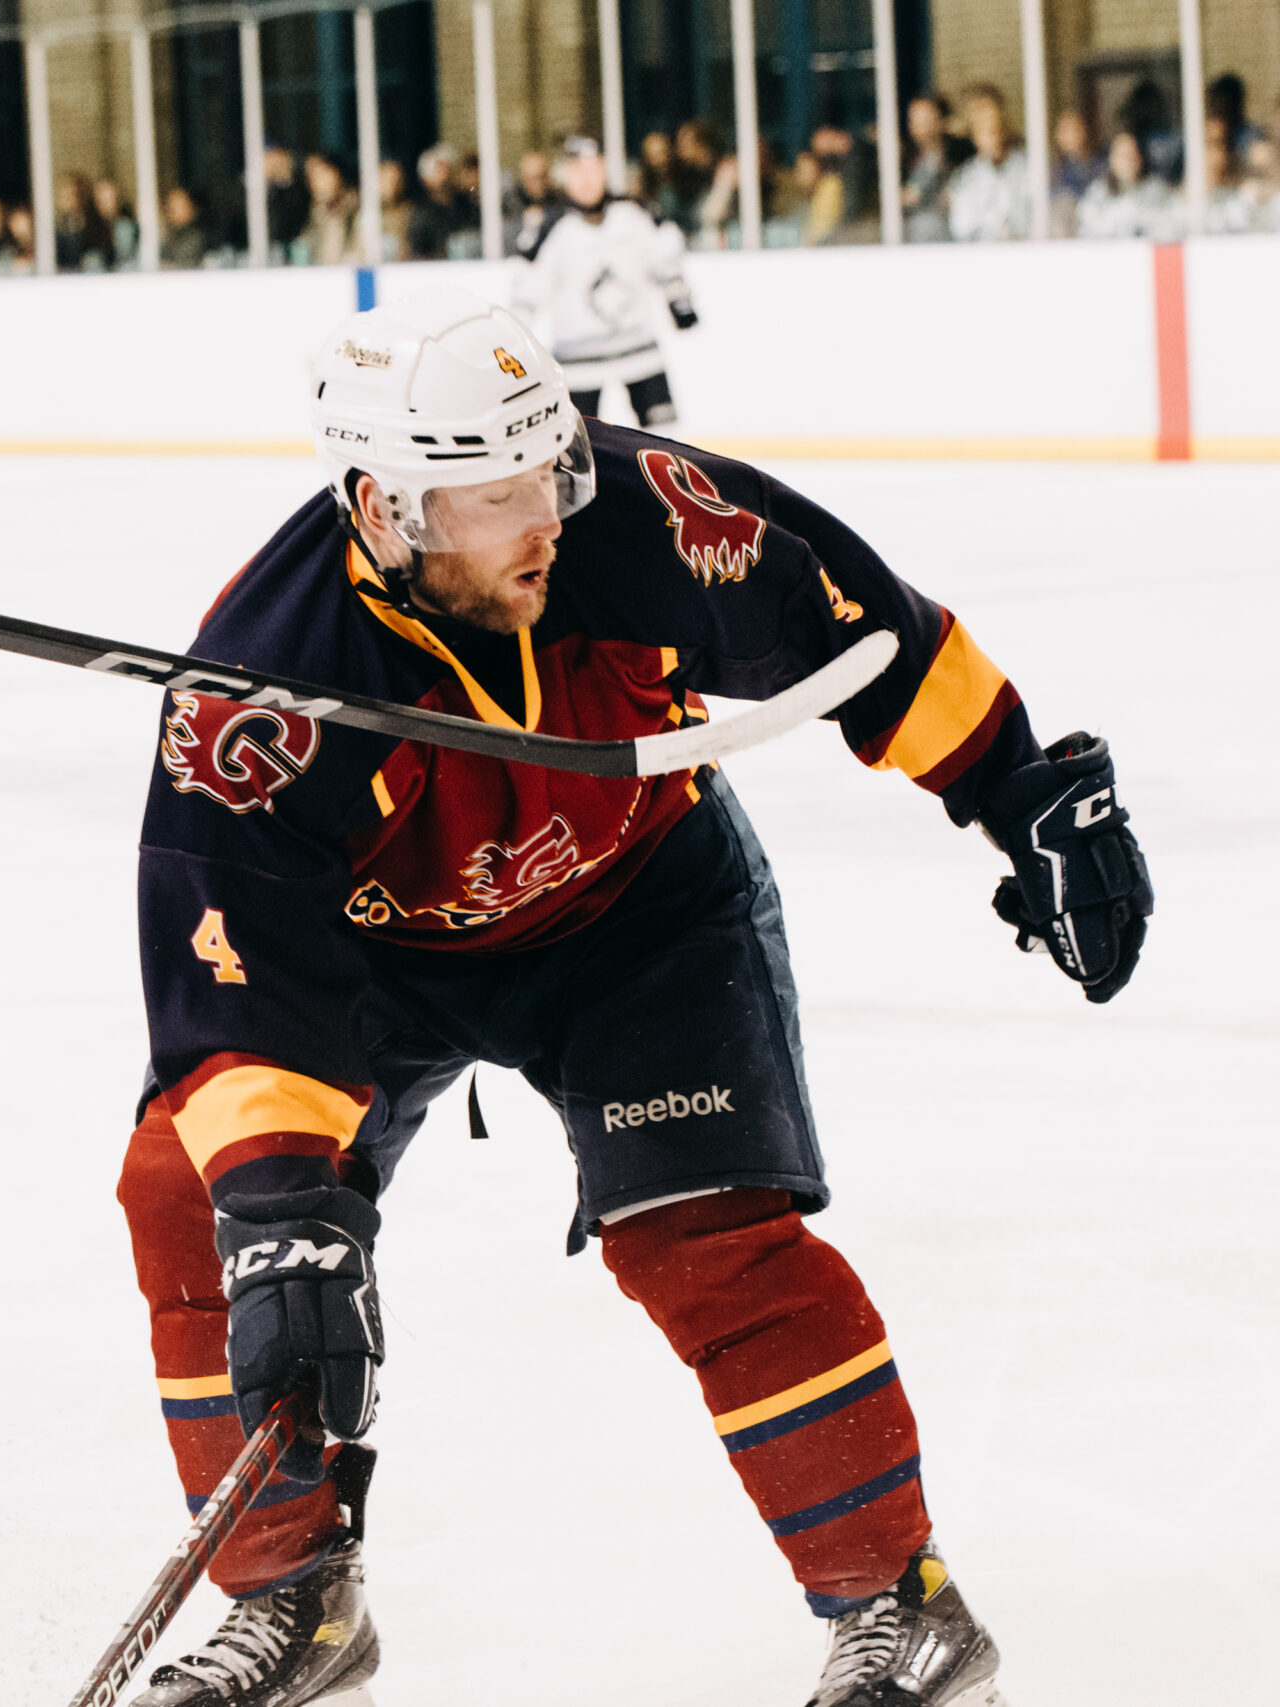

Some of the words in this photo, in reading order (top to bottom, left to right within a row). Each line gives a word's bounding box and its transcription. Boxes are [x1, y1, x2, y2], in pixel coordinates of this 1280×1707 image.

[493, 346, 527, 379] 4
[325, 426, 369, 444] CCM
[505, 401, 559, 438] CCM
[84, 651, 344, 719] CCM
[190, 905, 248, 986] 4
[602, 1084, 736, 1134] Reebok
[85, 1618, 157, 1707] PEED
